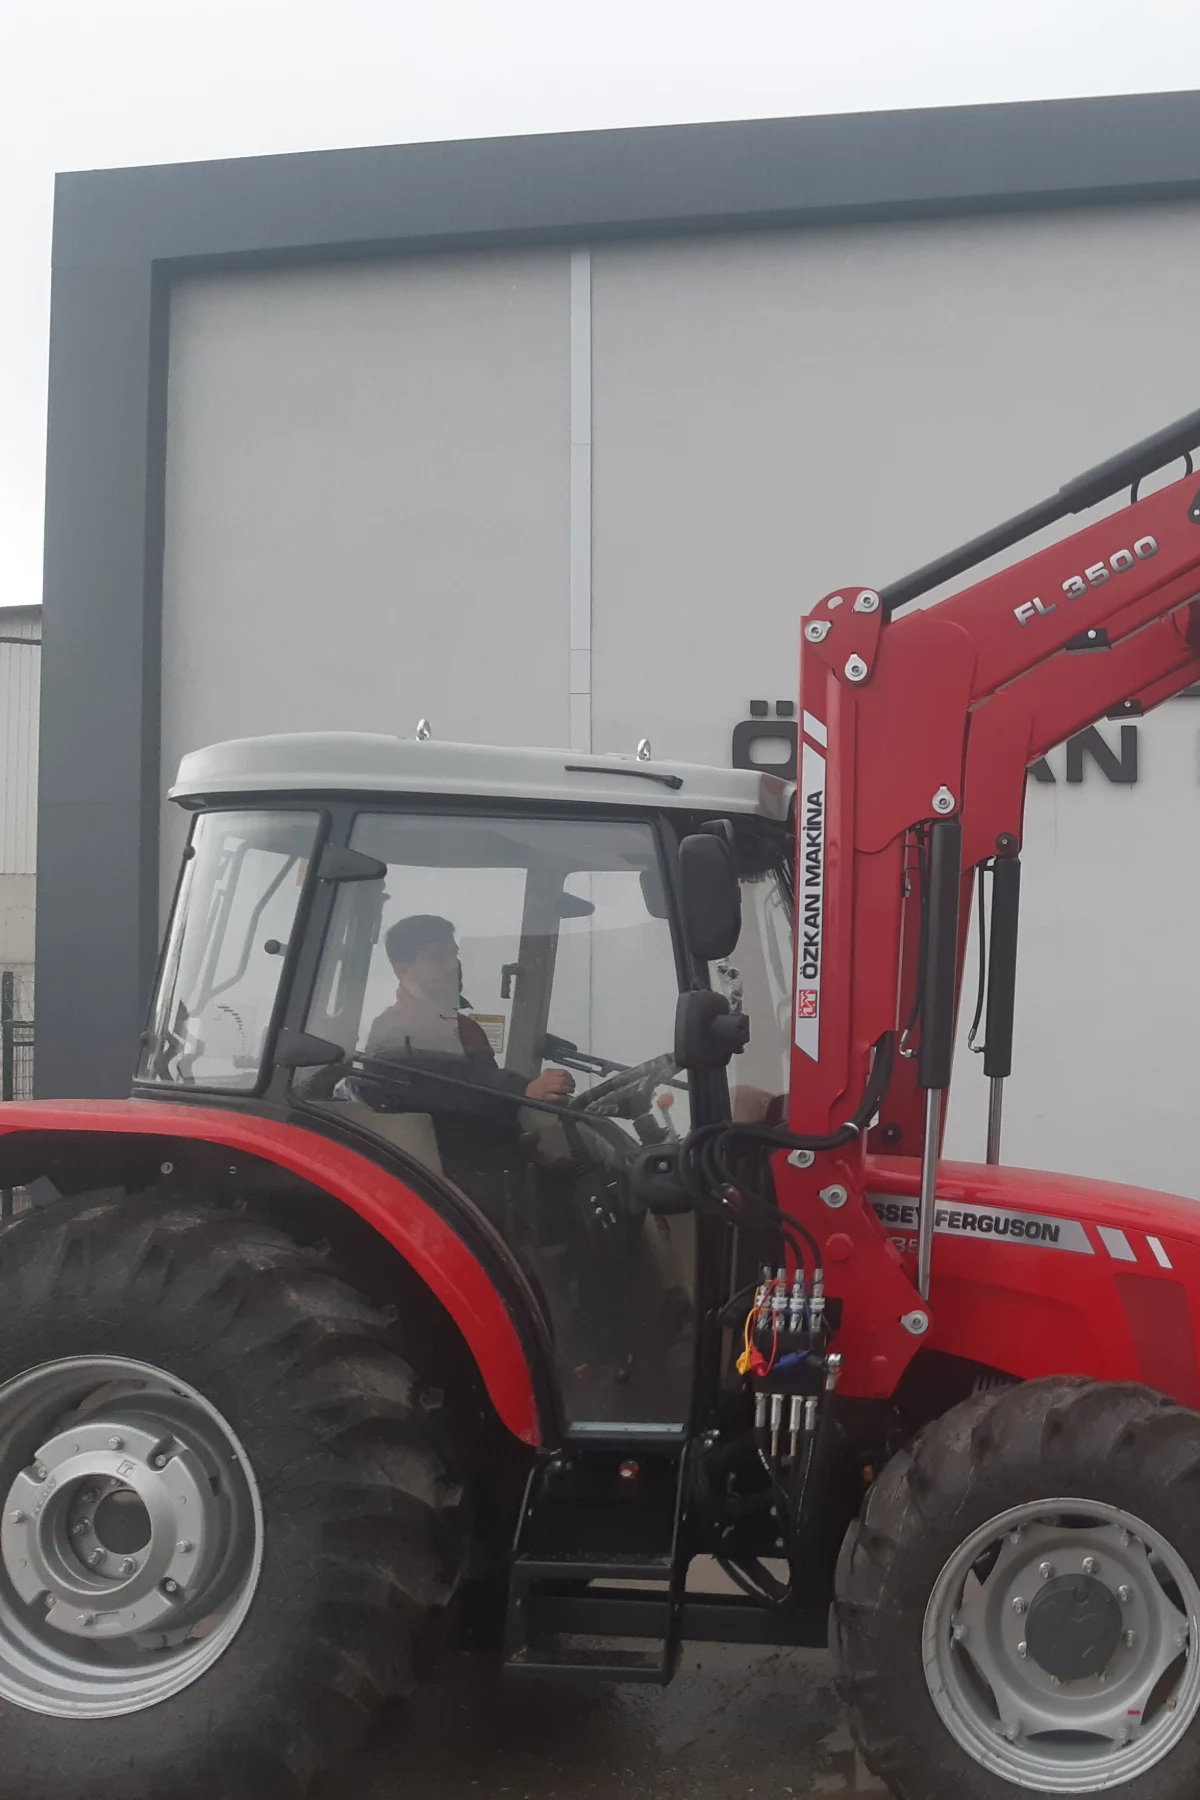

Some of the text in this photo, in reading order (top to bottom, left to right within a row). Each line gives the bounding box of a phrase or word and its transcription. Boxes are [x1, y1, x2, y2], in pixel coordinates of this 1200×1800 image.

[1013, 535, 1159, 628] FL 3500
[803, 790, 823, 887] MAKİNA
[800, 894, 821, 980] ÖZKAN
[935, 1209, 1060, 1243] FERGUSON
